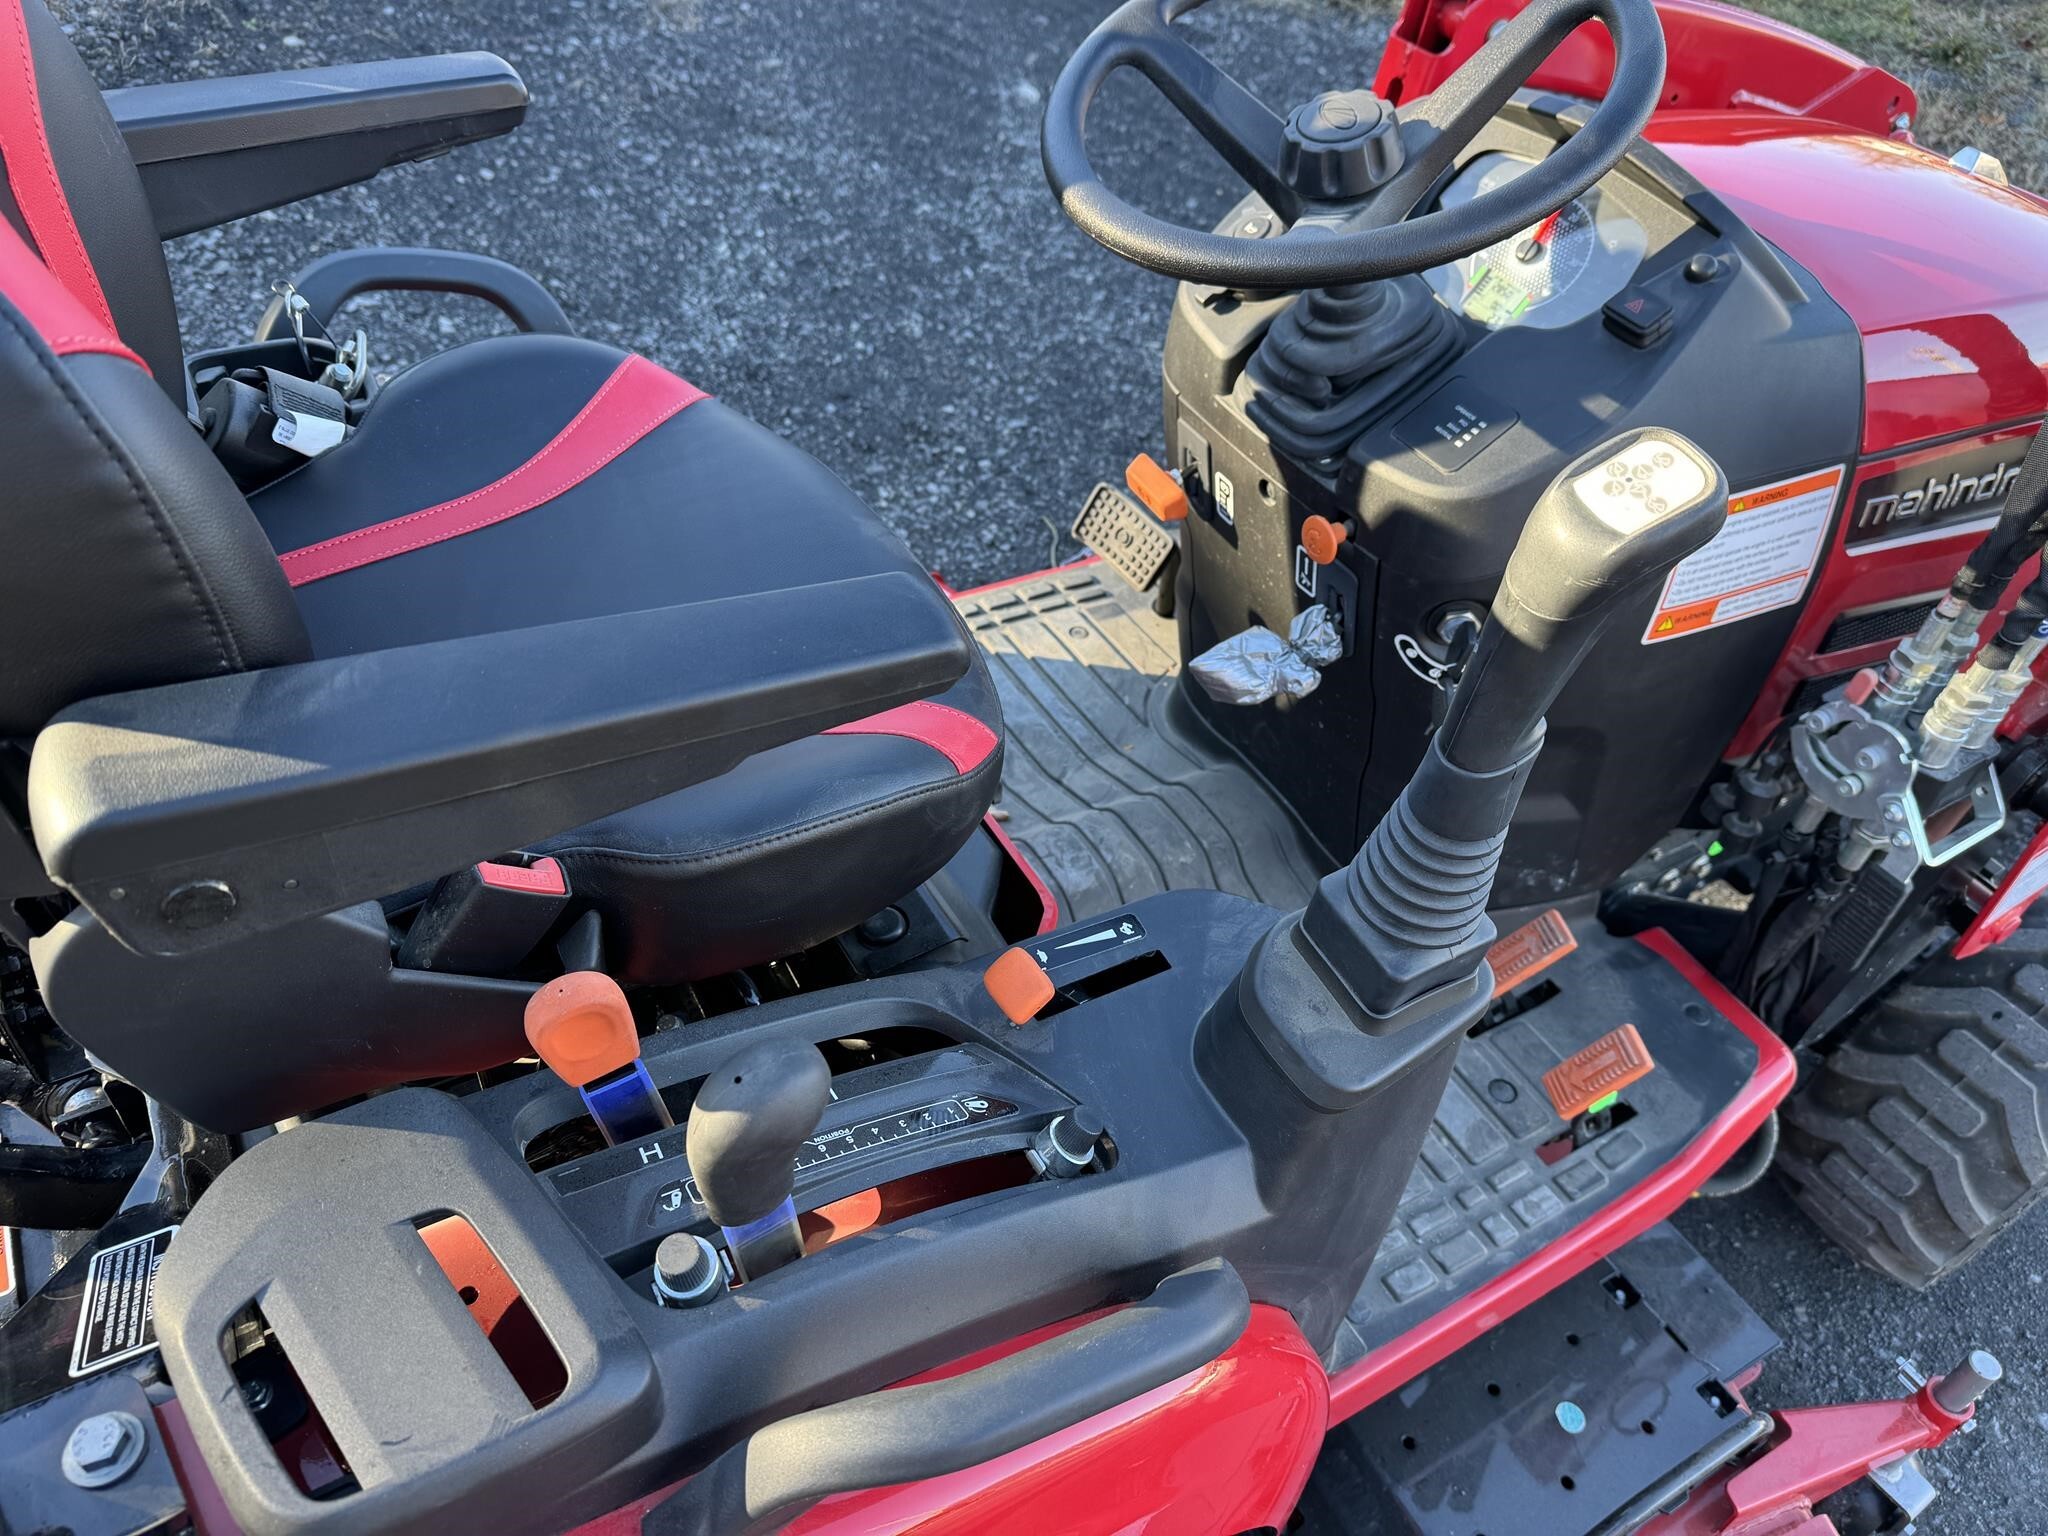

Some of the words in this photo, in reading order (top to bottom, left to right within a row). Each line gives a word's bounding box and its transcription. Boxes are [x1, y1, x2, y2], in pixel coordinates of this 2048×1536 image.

[1858, 462, 2022, 528] mahindr
[922, 1113, 932, 1121] 2
[898, 1119, 907, 1128] 3
[813, 1128, 850, 1143] POSITION
[871, 1127, 879, 1135] 4
[845, 1135, 854, 1144] 5
[817, 1144, 827, 1152] 6
[638, 1142, 664, 1164] H
